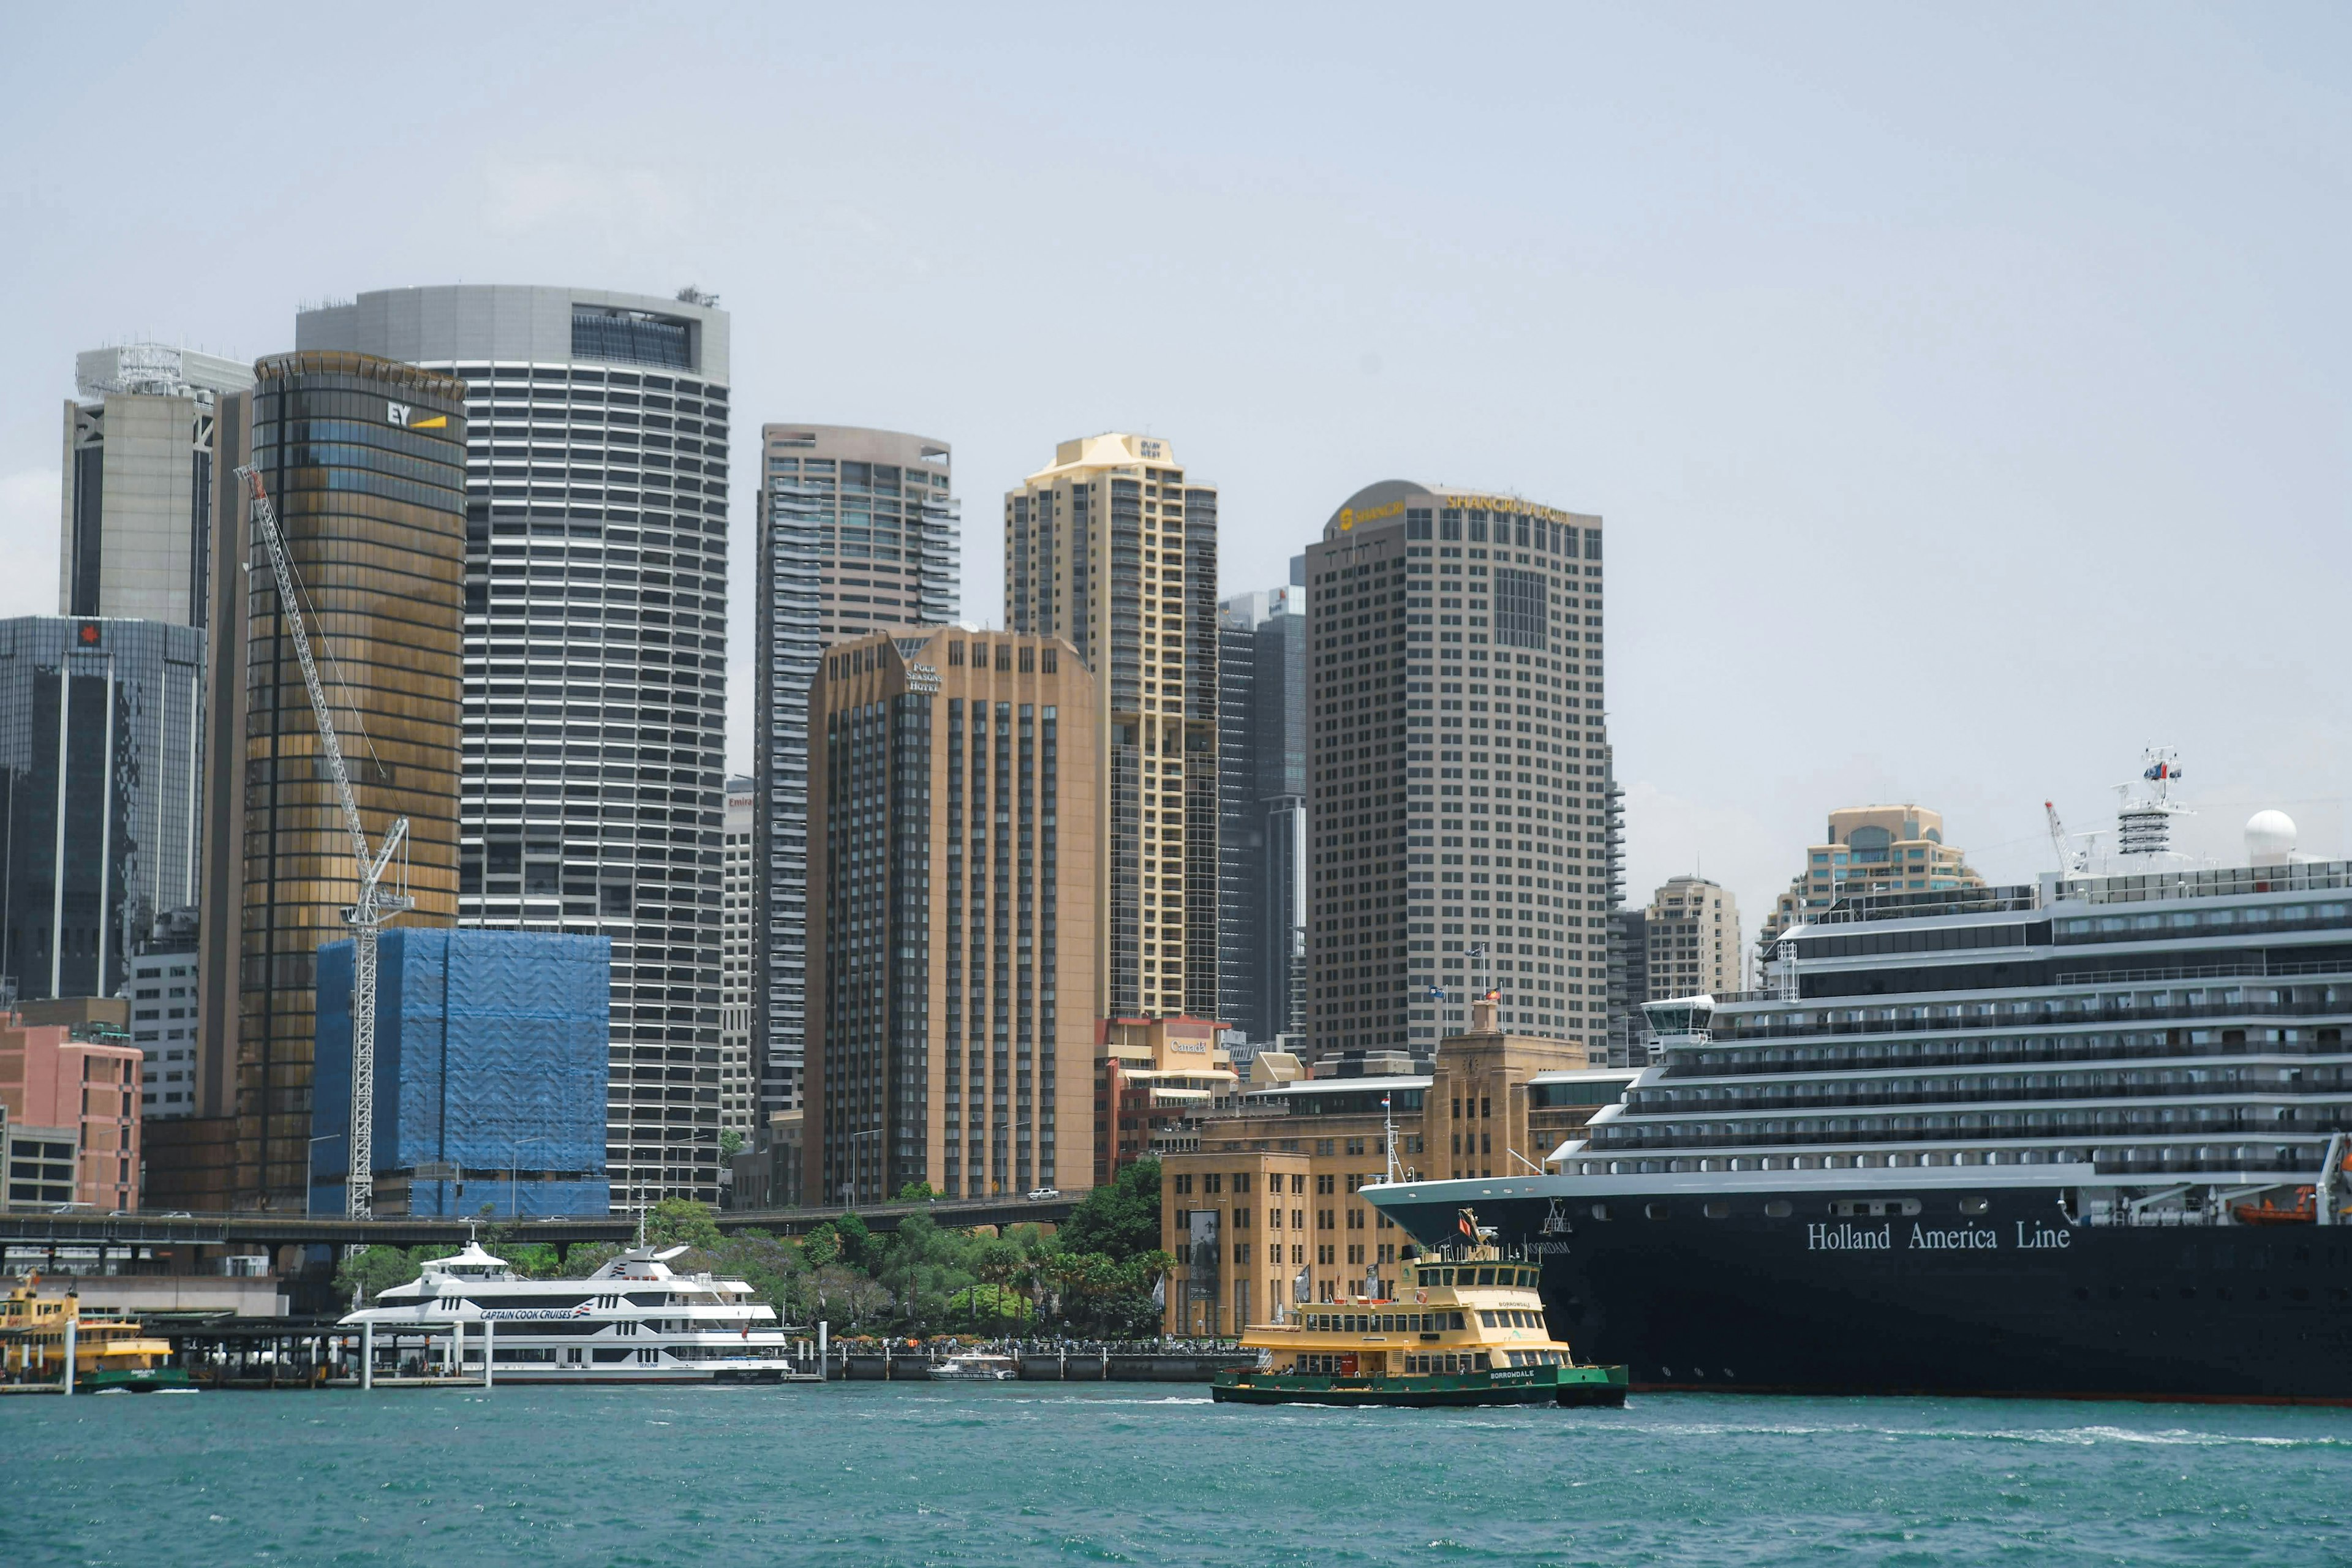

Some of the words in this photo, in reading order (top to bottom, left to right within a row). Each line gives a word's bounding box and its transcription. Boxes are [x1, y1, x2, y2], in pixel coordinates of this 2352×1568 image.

[388, 401, 411, 426] EY
[913, 663, 936, 672] FOUR
[907, 670, 942, 682] SEASONS
[910, 681, 939, 692] HOTEL
[729, 797, 753, 807] Emira
[1171, 1040, 1206, 1053] Canada
[1807, 1222, 1890, 1250] Holland
[1909, 1221, 1997, 1250] America
[2017, 1220, 2070, 1249] Line
[480, 1311, 515, 1320] CAPTAIN
[515, 1310, 540, 1319] COOK
[540, 1310, 572, 1319] CRUISES
[1491, 1370, 1534, 1379] BORROWDALE
